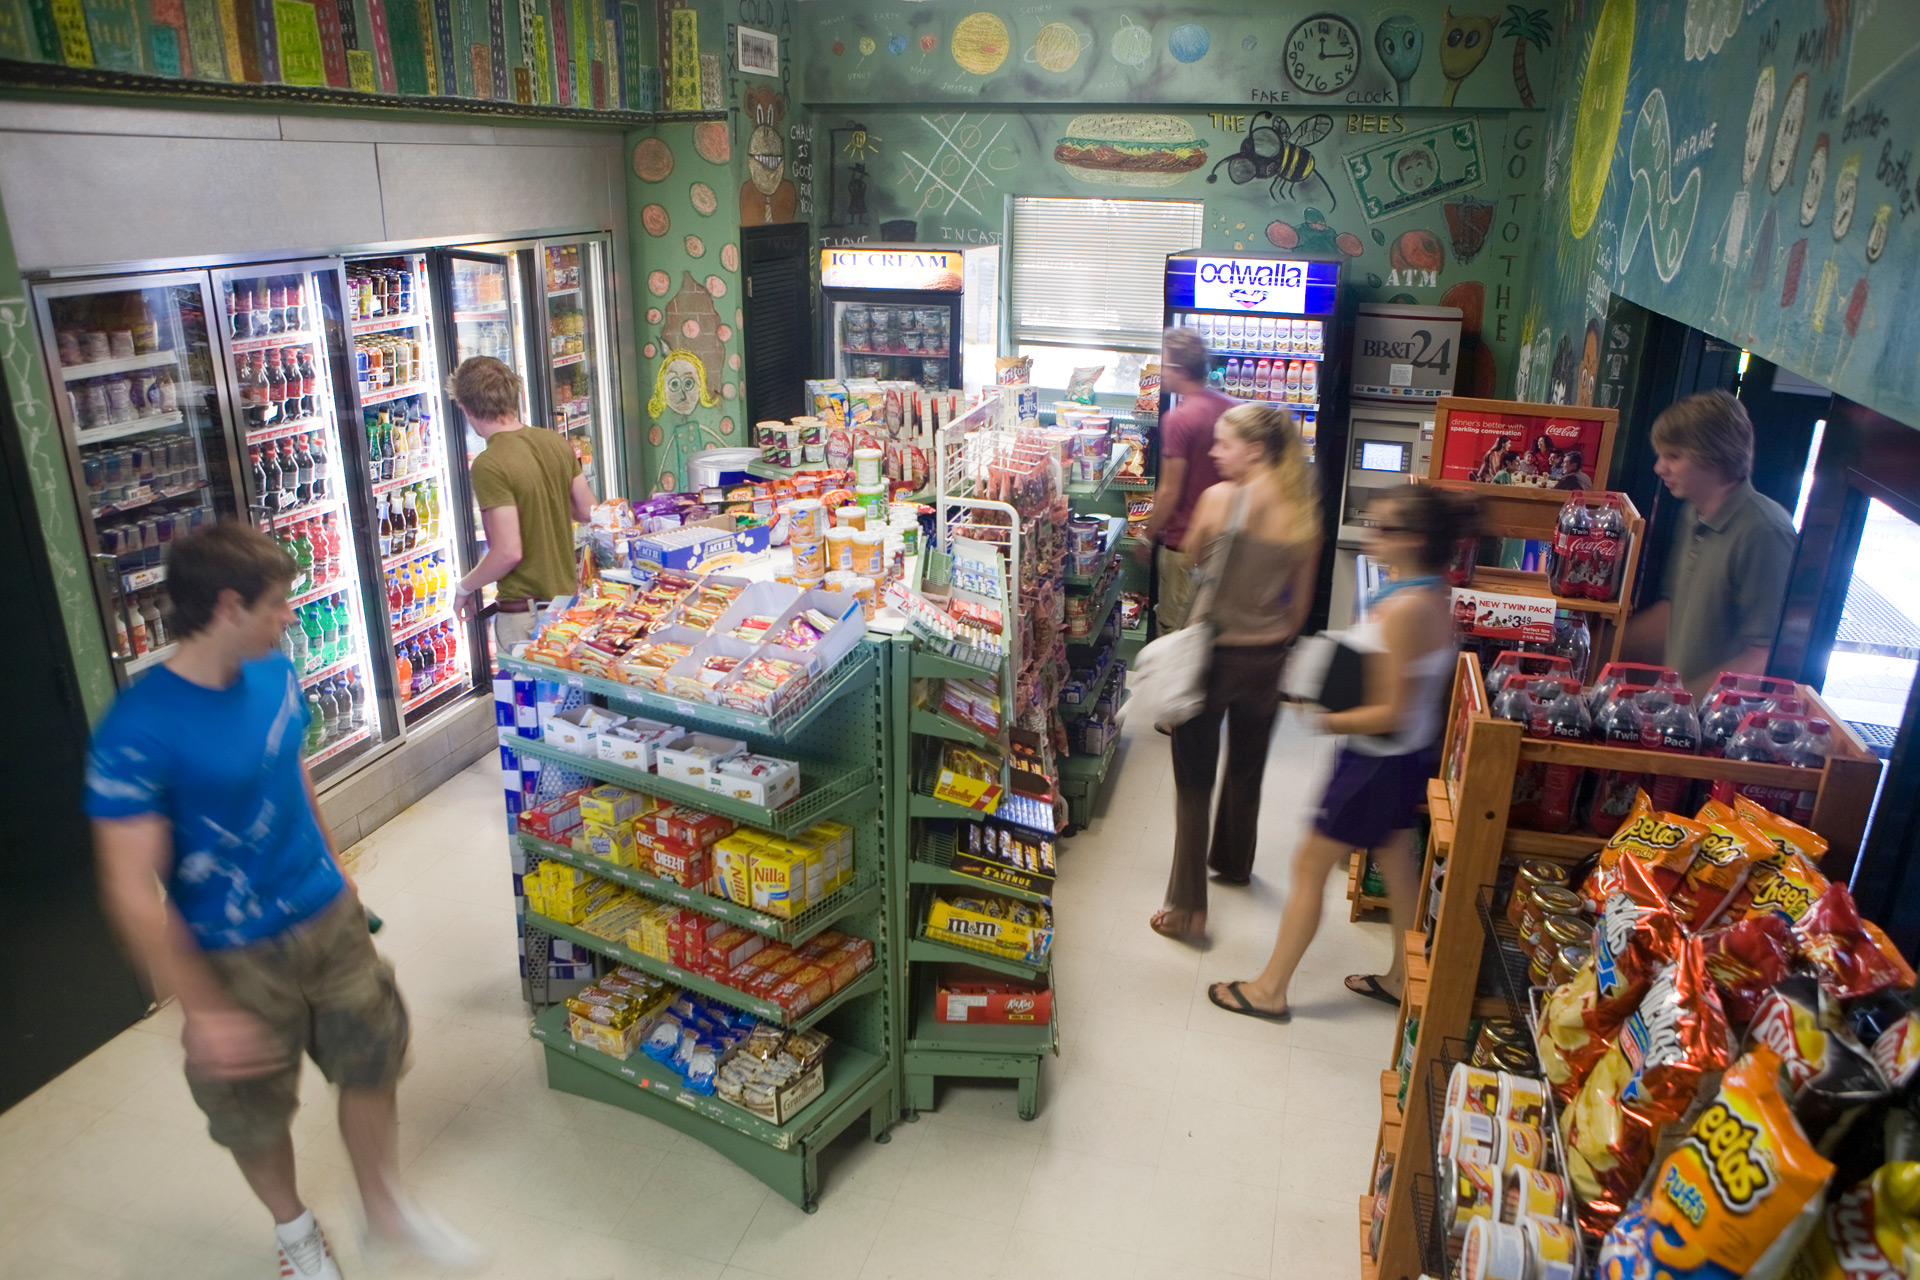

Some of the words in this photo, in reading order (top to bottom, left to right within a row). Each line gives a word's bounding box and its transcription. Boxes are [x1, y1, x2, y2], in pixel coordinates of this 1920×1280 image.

[740, 0, 774, 28] COLD
[727, 23, 740, 145] EXIT
[1251, 88, 1291, 104] FAKE
[1346, 88, 1394, 104] CLOCK
[1207, 112, 1246, 134] THE
[1347, 113, 1407, 134] BEES
[790, 125, 814, 141] CHALK
[798, 145, 809, 157] IS
[792, 161, 814, 181] GOOD
[800, 183, 812, 199] FOR
[832, 253, 863, 266] ICE
[868, 254, 948, 268] CREAM
[1200, 261, 1302, 287] odwalla
[1385, 269, 1437, 287] ATM
[1363, 339, 1415, 360] BB&T
[1411, 330, 1451, 376] 24
[1001, 363, 1031, 384] Fritos
[1139, 373, 1160, 389] Frito
[1451, 419, 1480, 428] dinner's
[1545, 424, 1581, 438] Coca-Cola
[1129, 501, 1154, 515] Frito
[709, 541, 722, 554] ACT
[1479, 600, 1500, 609] NEW
[1503, 602, 1526, 611] TWIN
[1528, 605, 1552, 614] PACK
[1554, 726, 1580, 737] Pack
[1613, 729, 1639, 741] Twin
[1664, 736, 1691, 748] Pack
[653, 849, 685, 872] CHEEZ-IT
[754, 867, 785, 883] Nilla
[1698, 1104, 1766, 1201] eetos
